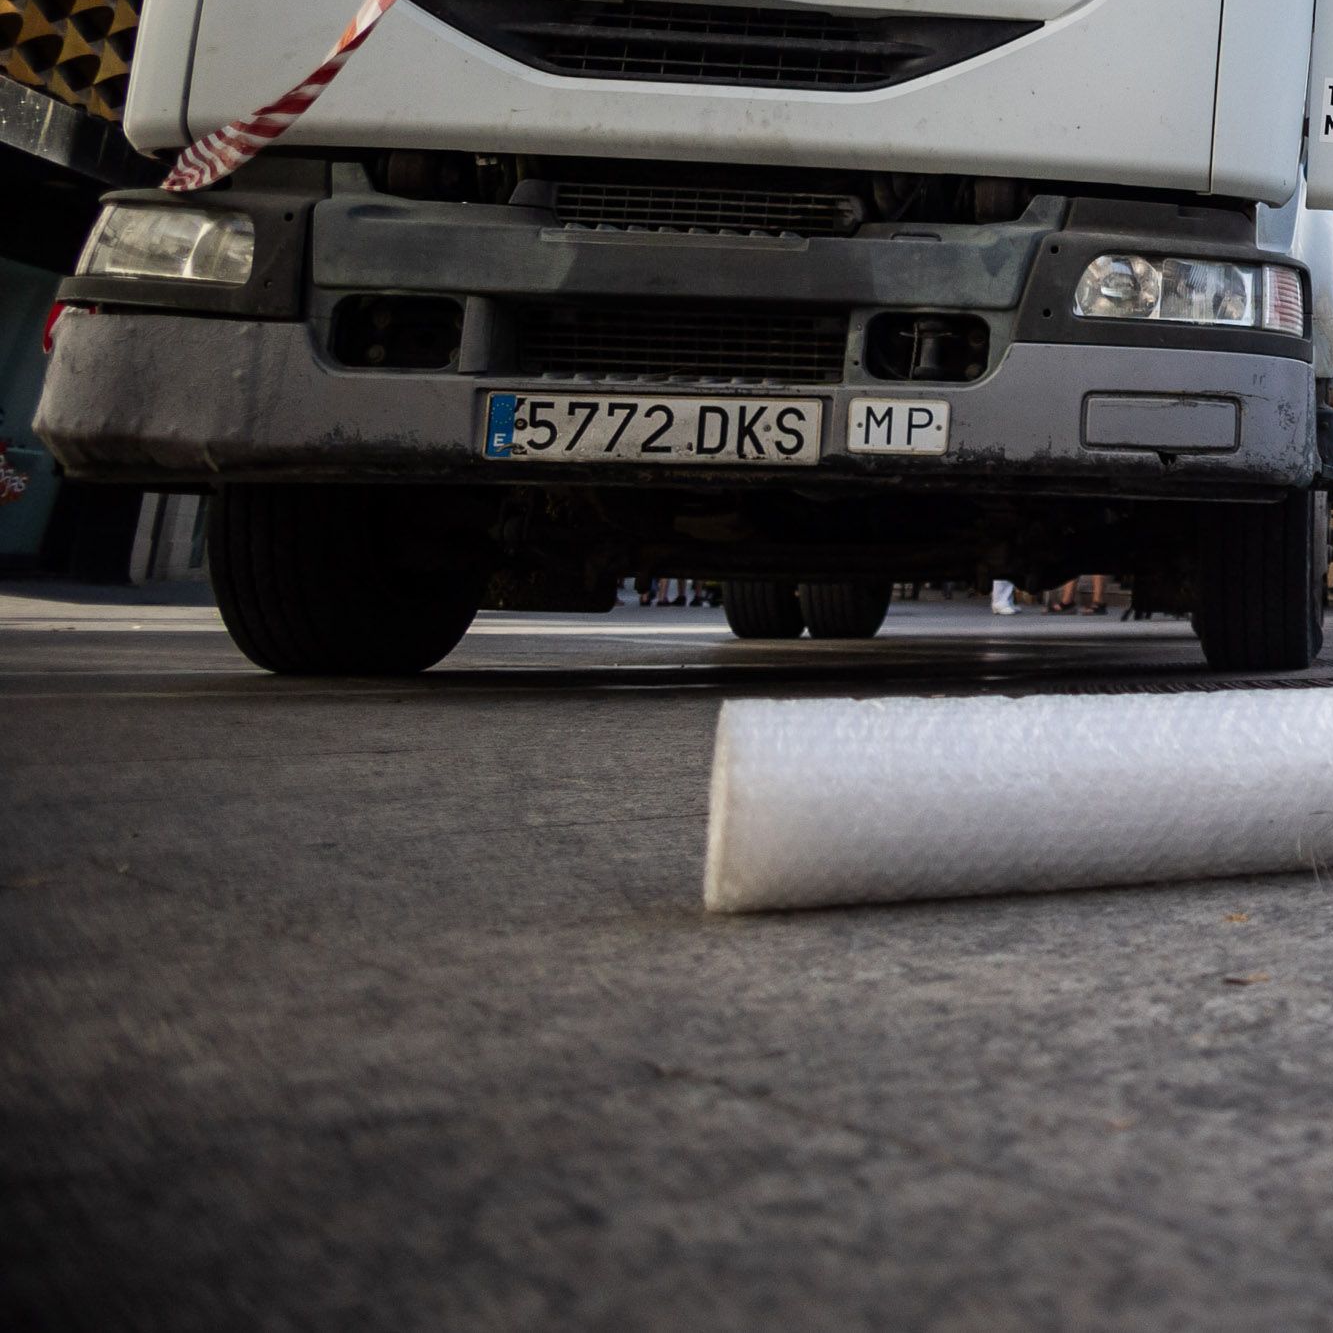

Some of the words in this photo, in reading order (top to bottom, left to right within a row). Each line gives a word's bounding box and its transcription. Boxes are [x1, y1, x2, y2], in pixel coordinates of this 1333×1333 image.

[493, 433, 506, 447] E
[526, 401, 675, 454] 5772
[697, 405, 807, 457] DKS
